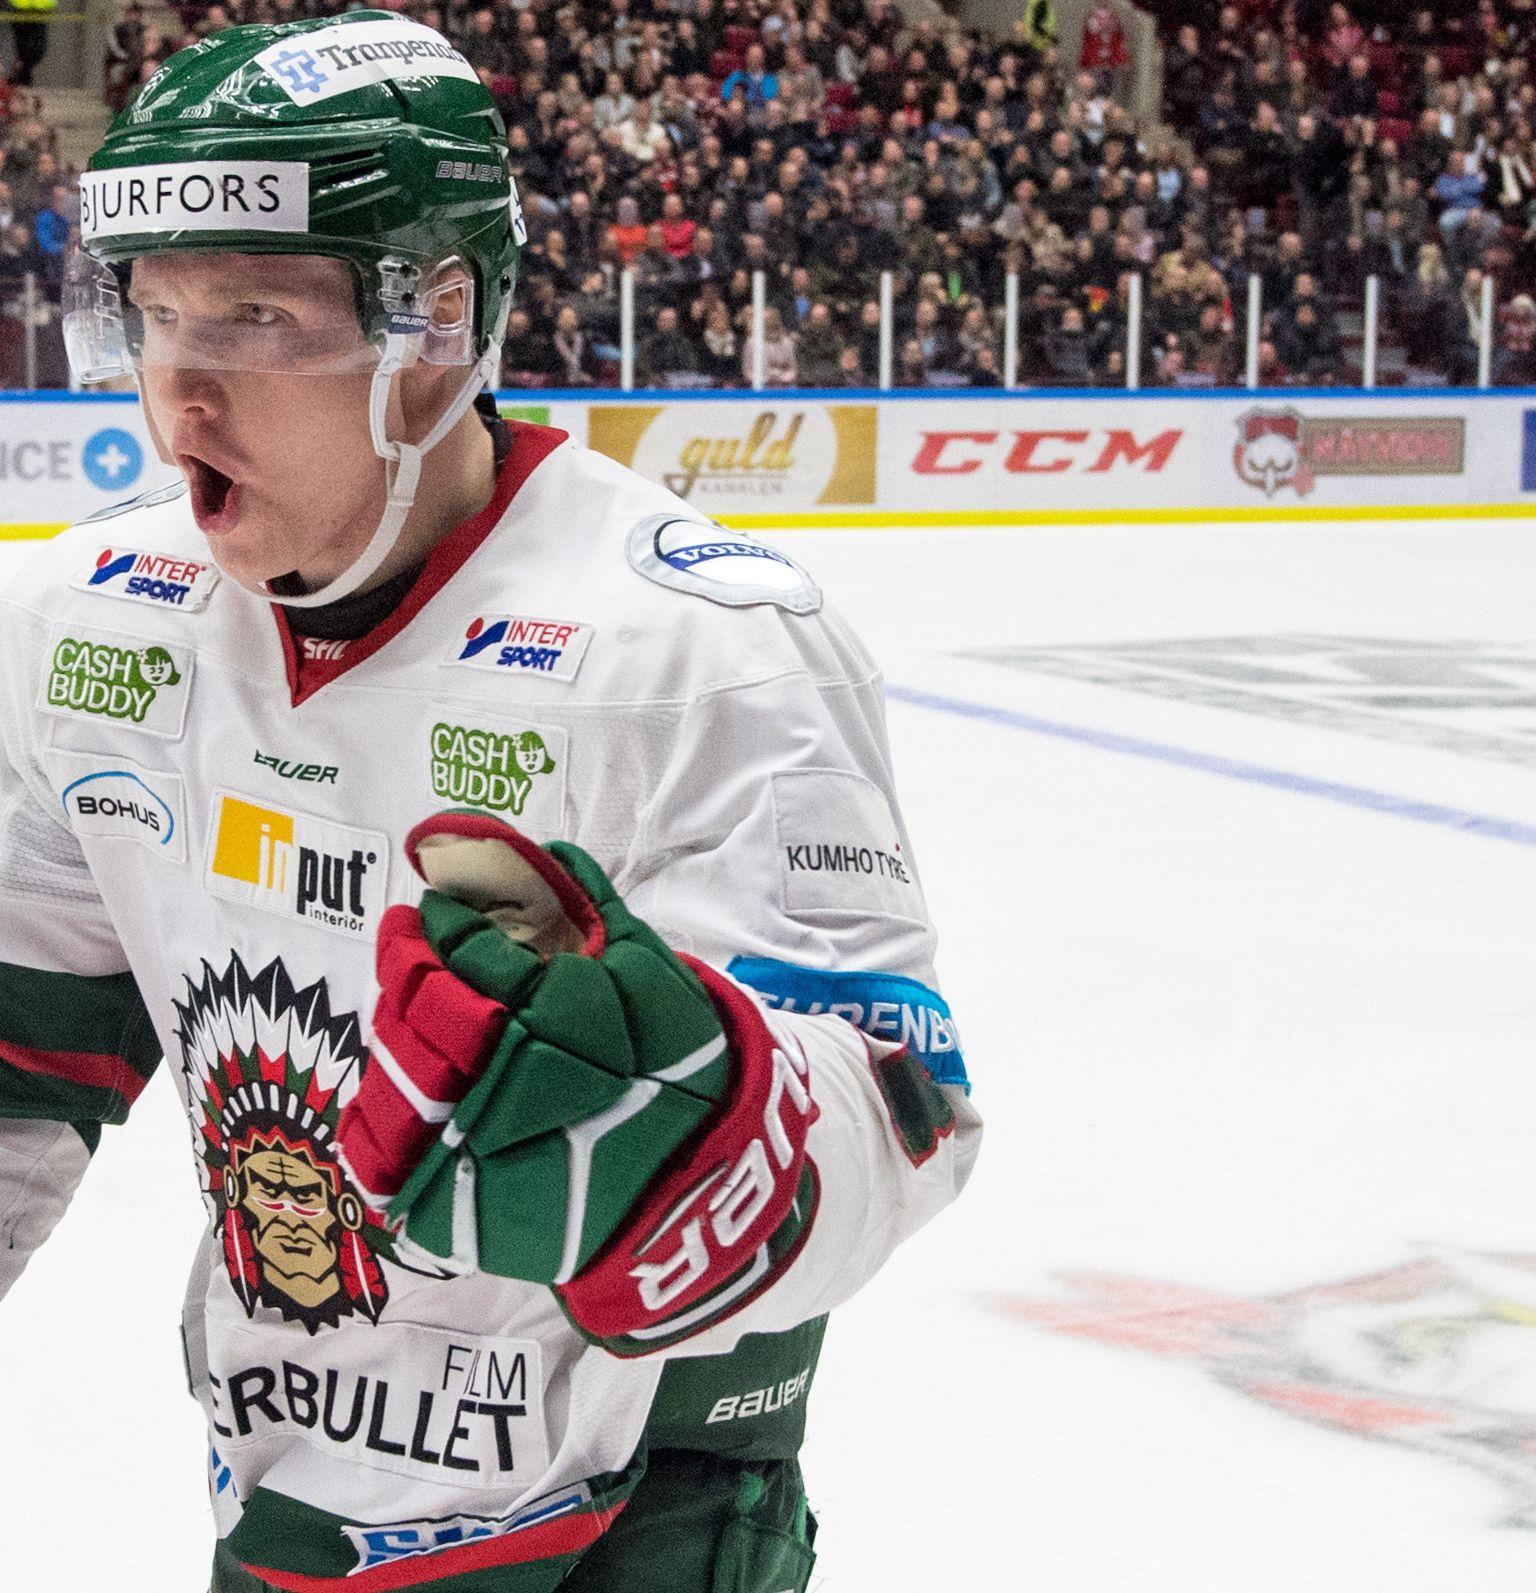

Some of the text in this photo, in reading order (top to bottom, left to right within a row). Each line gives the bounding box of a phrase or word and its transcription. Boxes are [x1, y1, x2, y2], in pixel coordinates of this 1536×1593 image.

[82, 174, 280, 231] BJURFORS
[662, 411, 805, 499] guld
[911, 428, 1184, 475] CCM
[125, 576, 191, 605] SPORT
[135, 554, 200, 584] INTER
[506, 620, 572, 647] INTER
[56, 642, 133, 684] CASH
[496, 646, 562, 671] SPORT
[49, 672, 152, 719] BUDDY
[433, 728, 509, 773] CASH
[433, 761, 529, 811] BUDDY
[76, 796, 161, 831] BOHUS
[786, 844, 873, 874] KUMHO
[705, 1366, 811, 1425] BAUER
